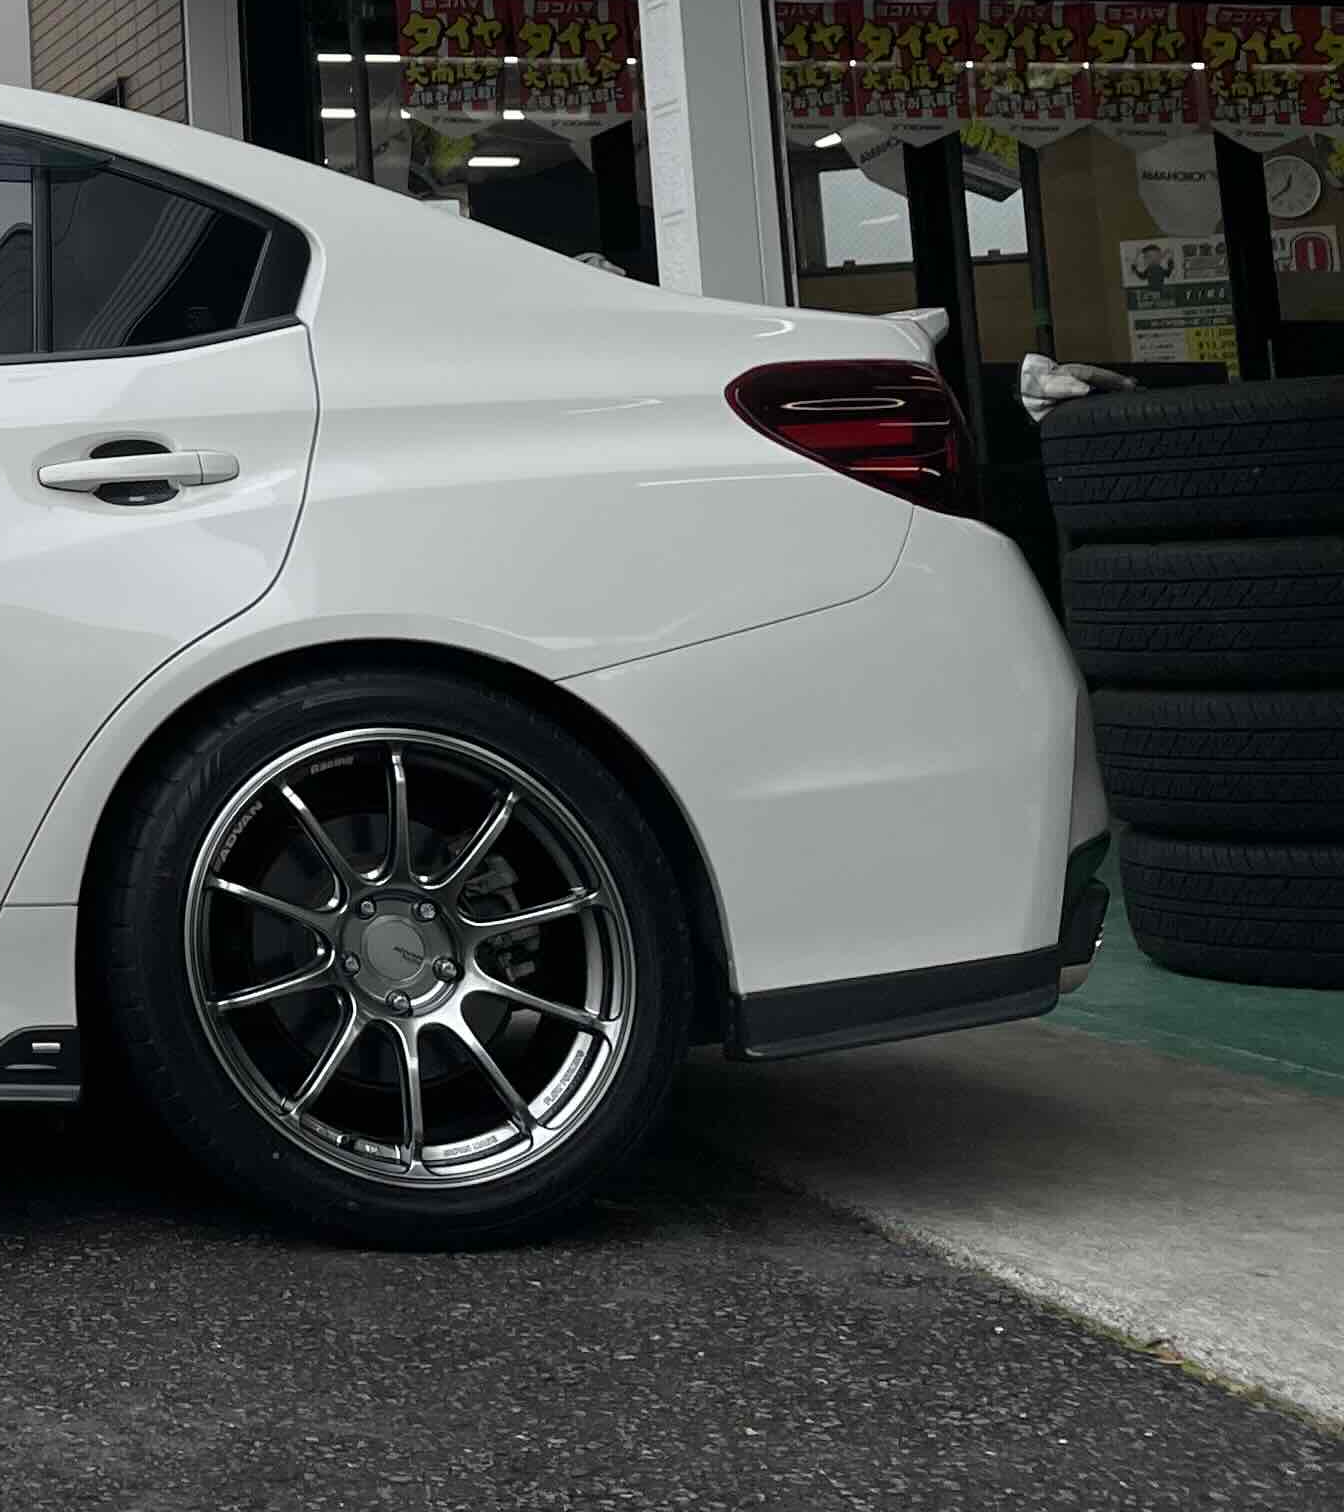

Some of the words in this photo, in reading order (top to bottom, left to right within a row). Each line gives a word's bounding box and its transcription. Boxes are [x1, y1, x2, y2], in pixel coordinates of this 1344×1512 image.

[401, 11, 503, 55] タイヤ
[518, 18, 620, 57] タイヤ
[782, 22, 847, 58] イヤ
[857, 22, 960, 62] タイヤ
[1088, 23, 1185, 65] タイヤ
[1200, 27, 1304, 71] タイヤ
